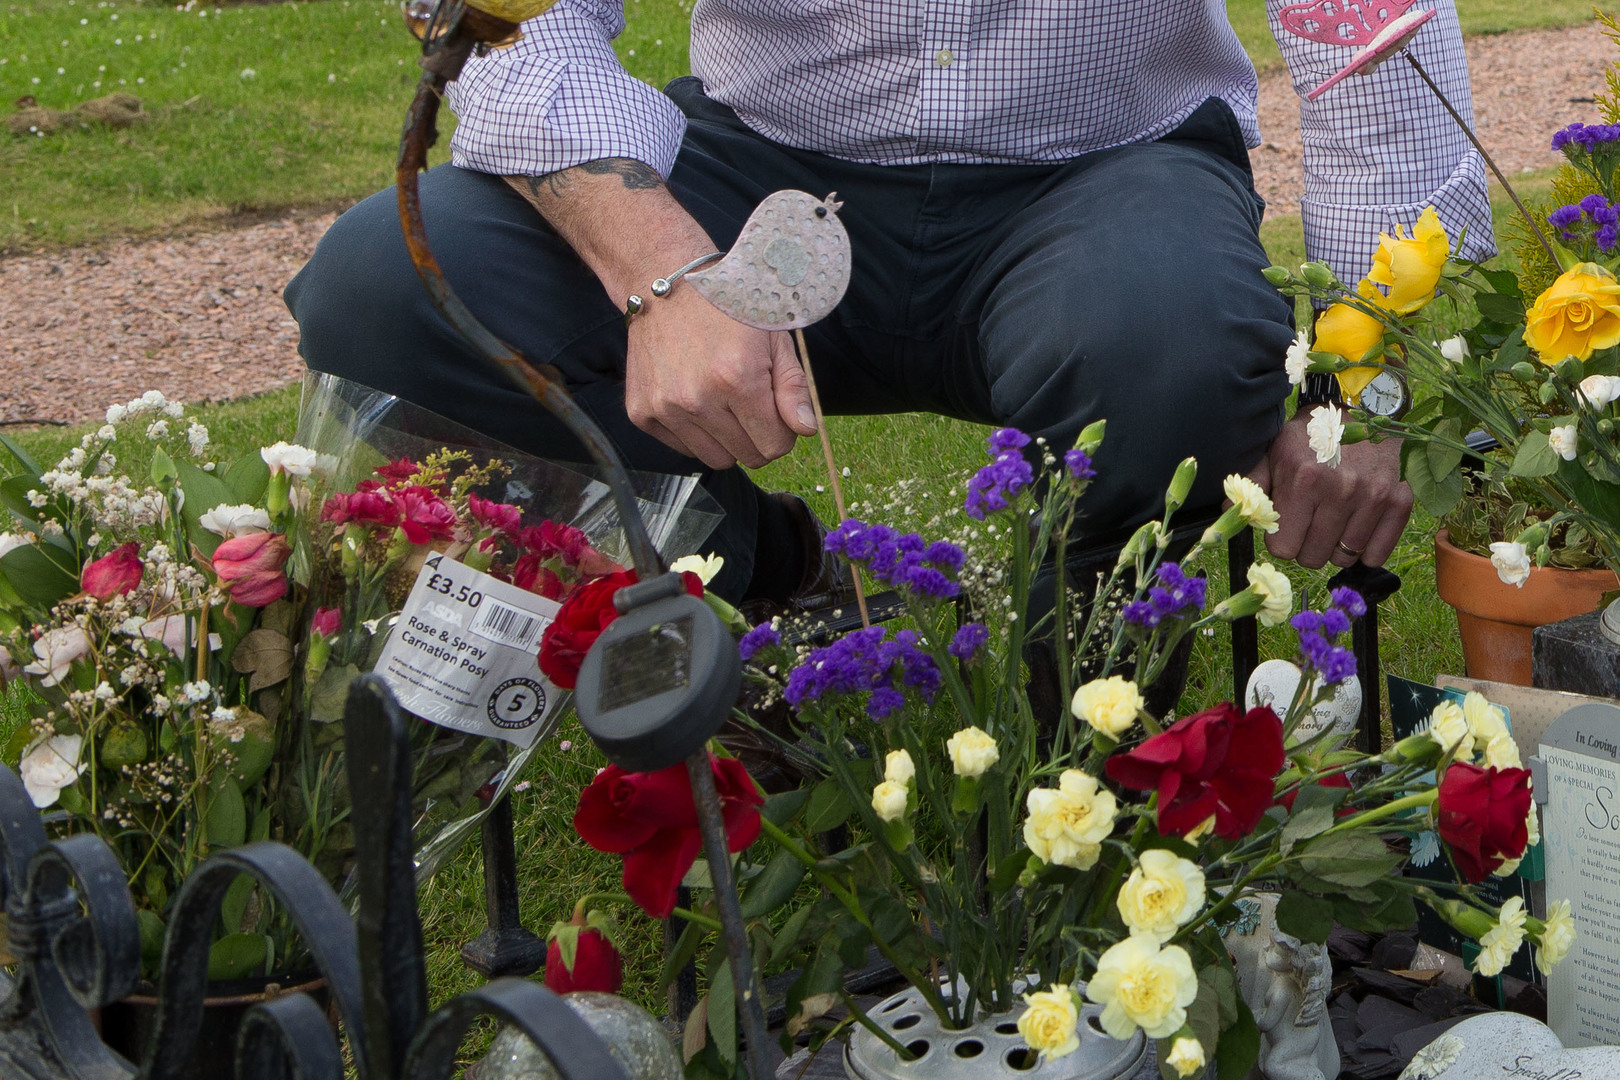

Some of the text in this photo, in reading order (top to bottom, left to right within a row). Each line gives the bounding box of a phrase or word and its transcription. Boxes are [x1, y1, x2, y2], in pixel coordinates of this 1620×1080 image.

[427, 573, 482, 608] £3.50
[422, 600, 463, 627] ASDA
[408, 616, 439, 637] Rose
[439, 630, 449, 643] &
[451, 636, 487, 661] Spray
[401, 630, 458, 666] Carnation
[460, 659, 489, 680] Posy
[507, 694, 527, 712] 5
[1575, 731, 1585, 744] In
[1587, 734, 1617, 758] Loving
[1544, 754, 1616, 780] LOVING MEMORIES
[1568, 776, 1595, 791] SPECIAL
[1583, 891, 1594, 901] You
[1613, 900, 1620, 908] far
